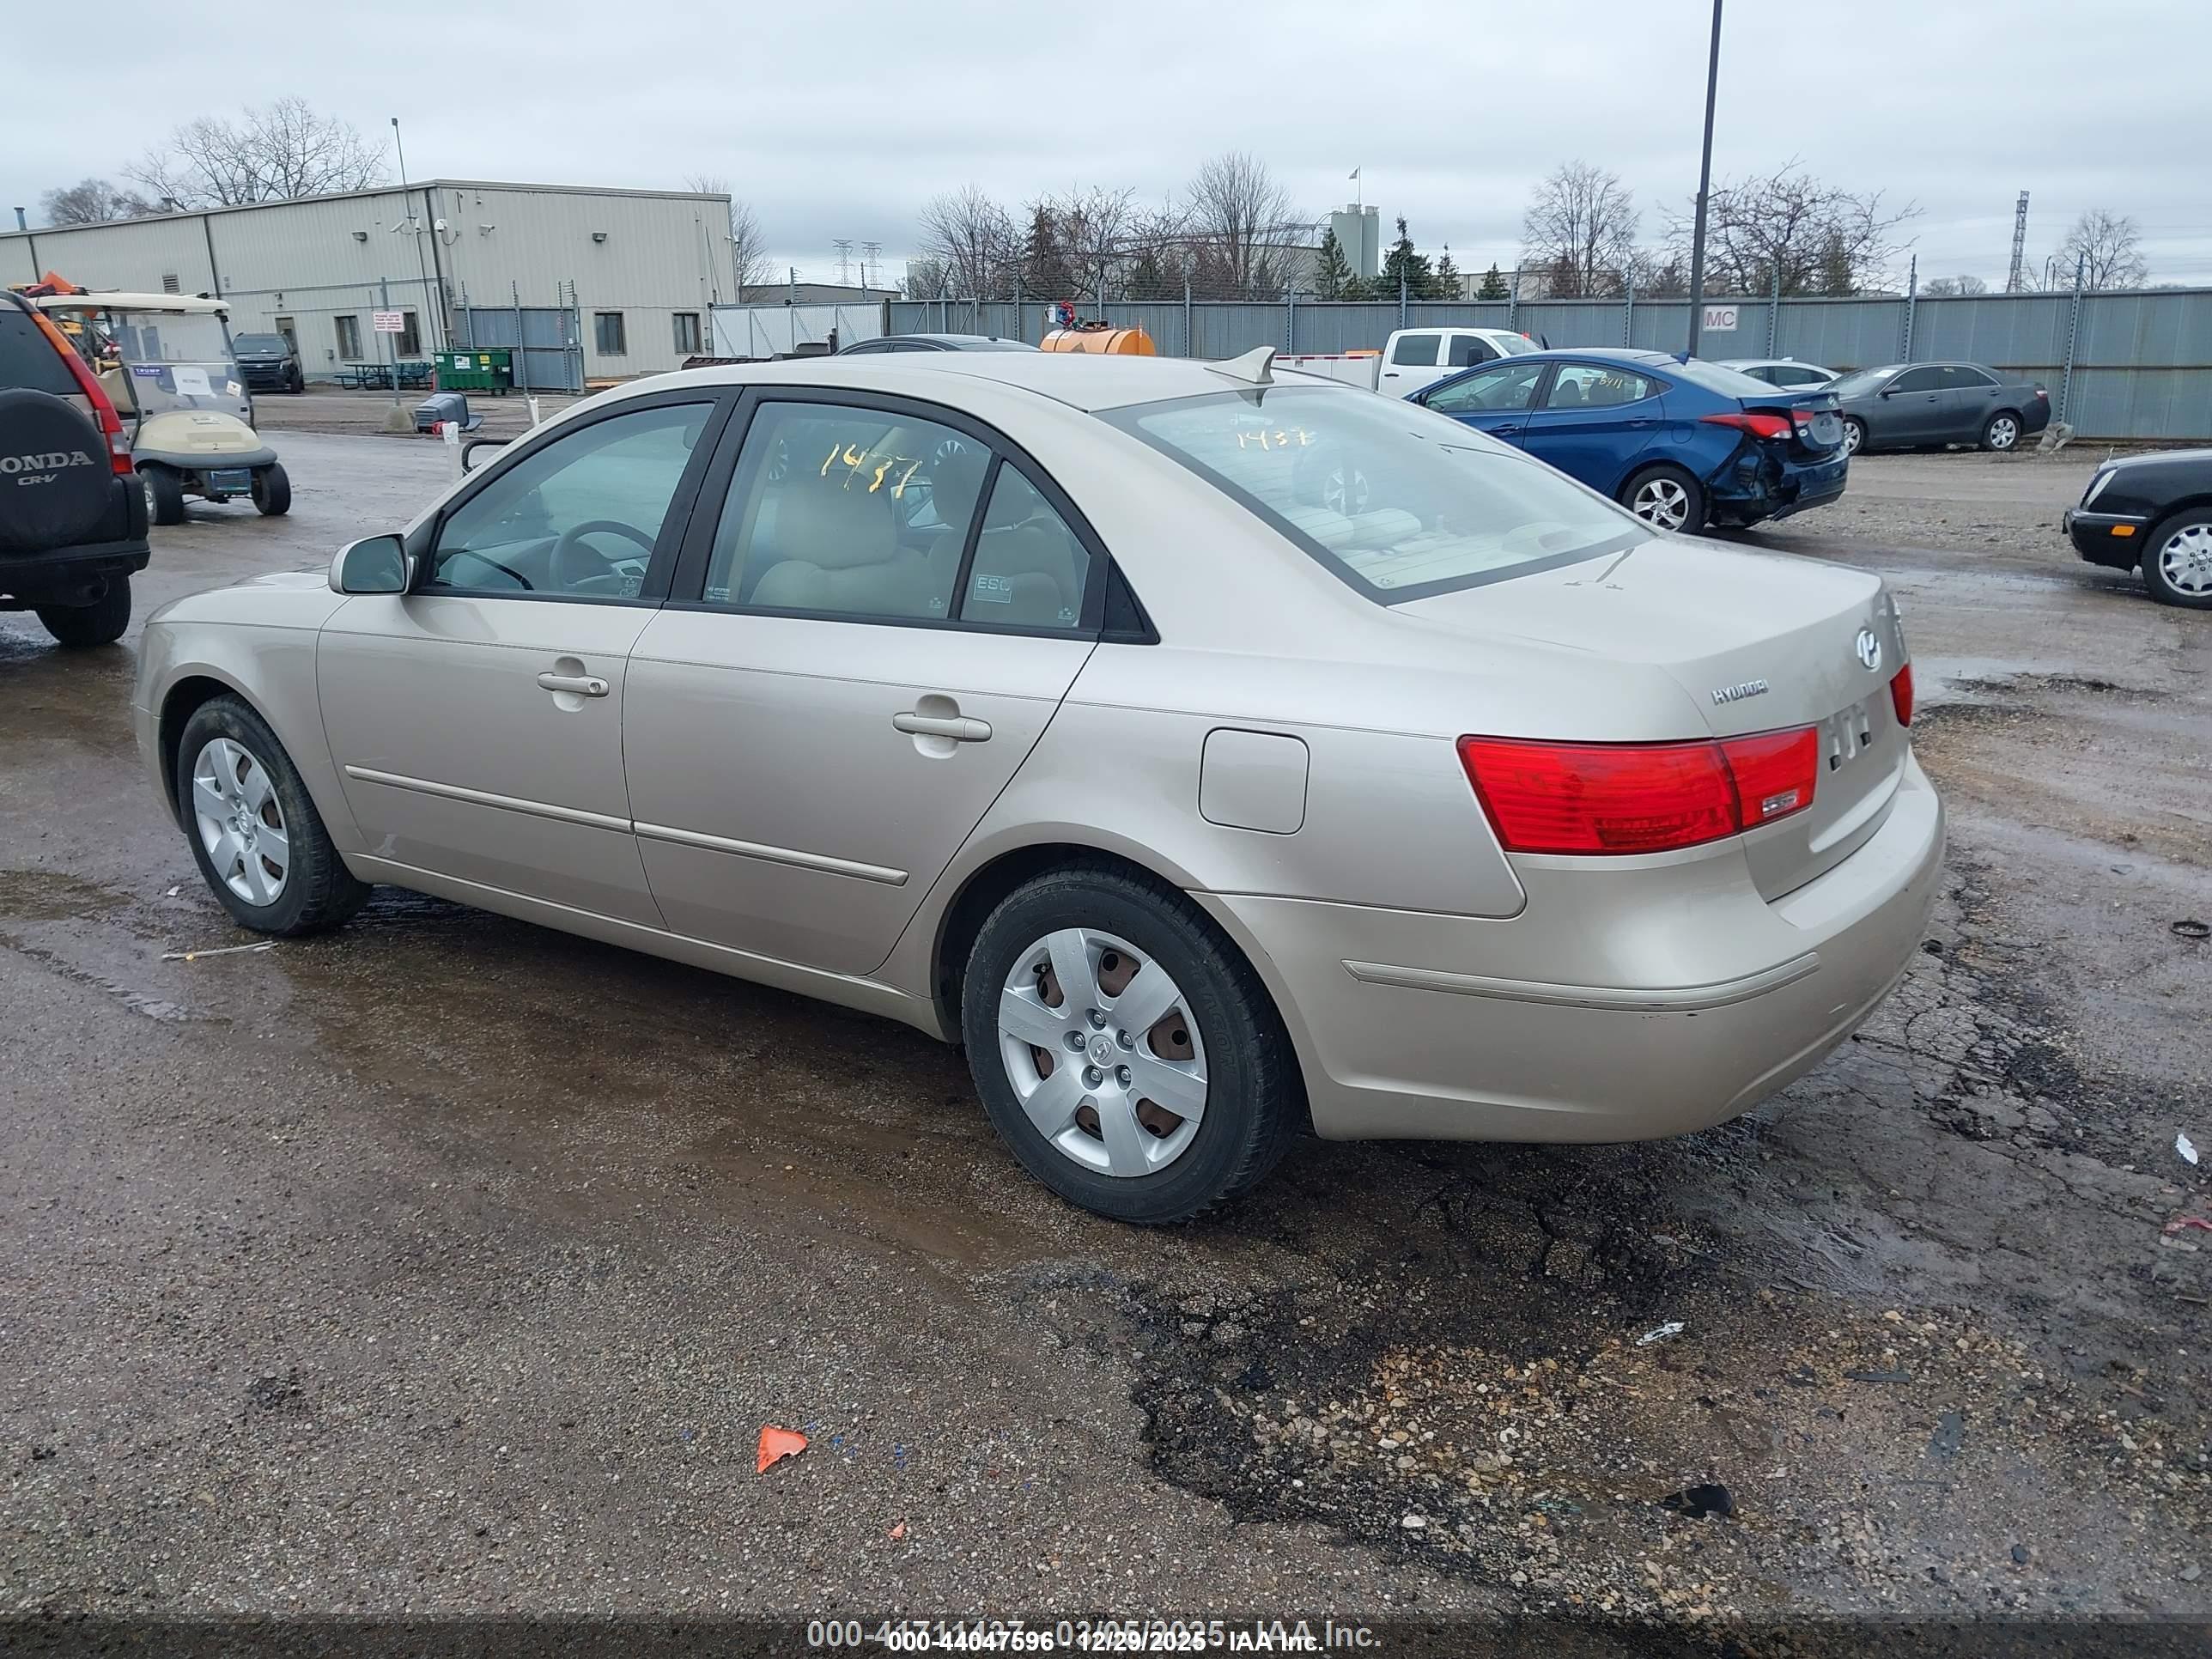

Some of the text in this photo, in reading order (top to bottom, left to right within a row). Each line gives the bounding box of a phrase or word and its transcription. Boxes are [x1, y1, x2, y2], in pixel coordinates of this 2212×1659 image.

[1707, 312, 1735, 325] MC
[0, 451, 95, 474] ONDA
[820, 443, 923, 498] 1437
[17, 473, 58, 485] CR-V
[1711, 679, 1771, 705] HYUNDAI
